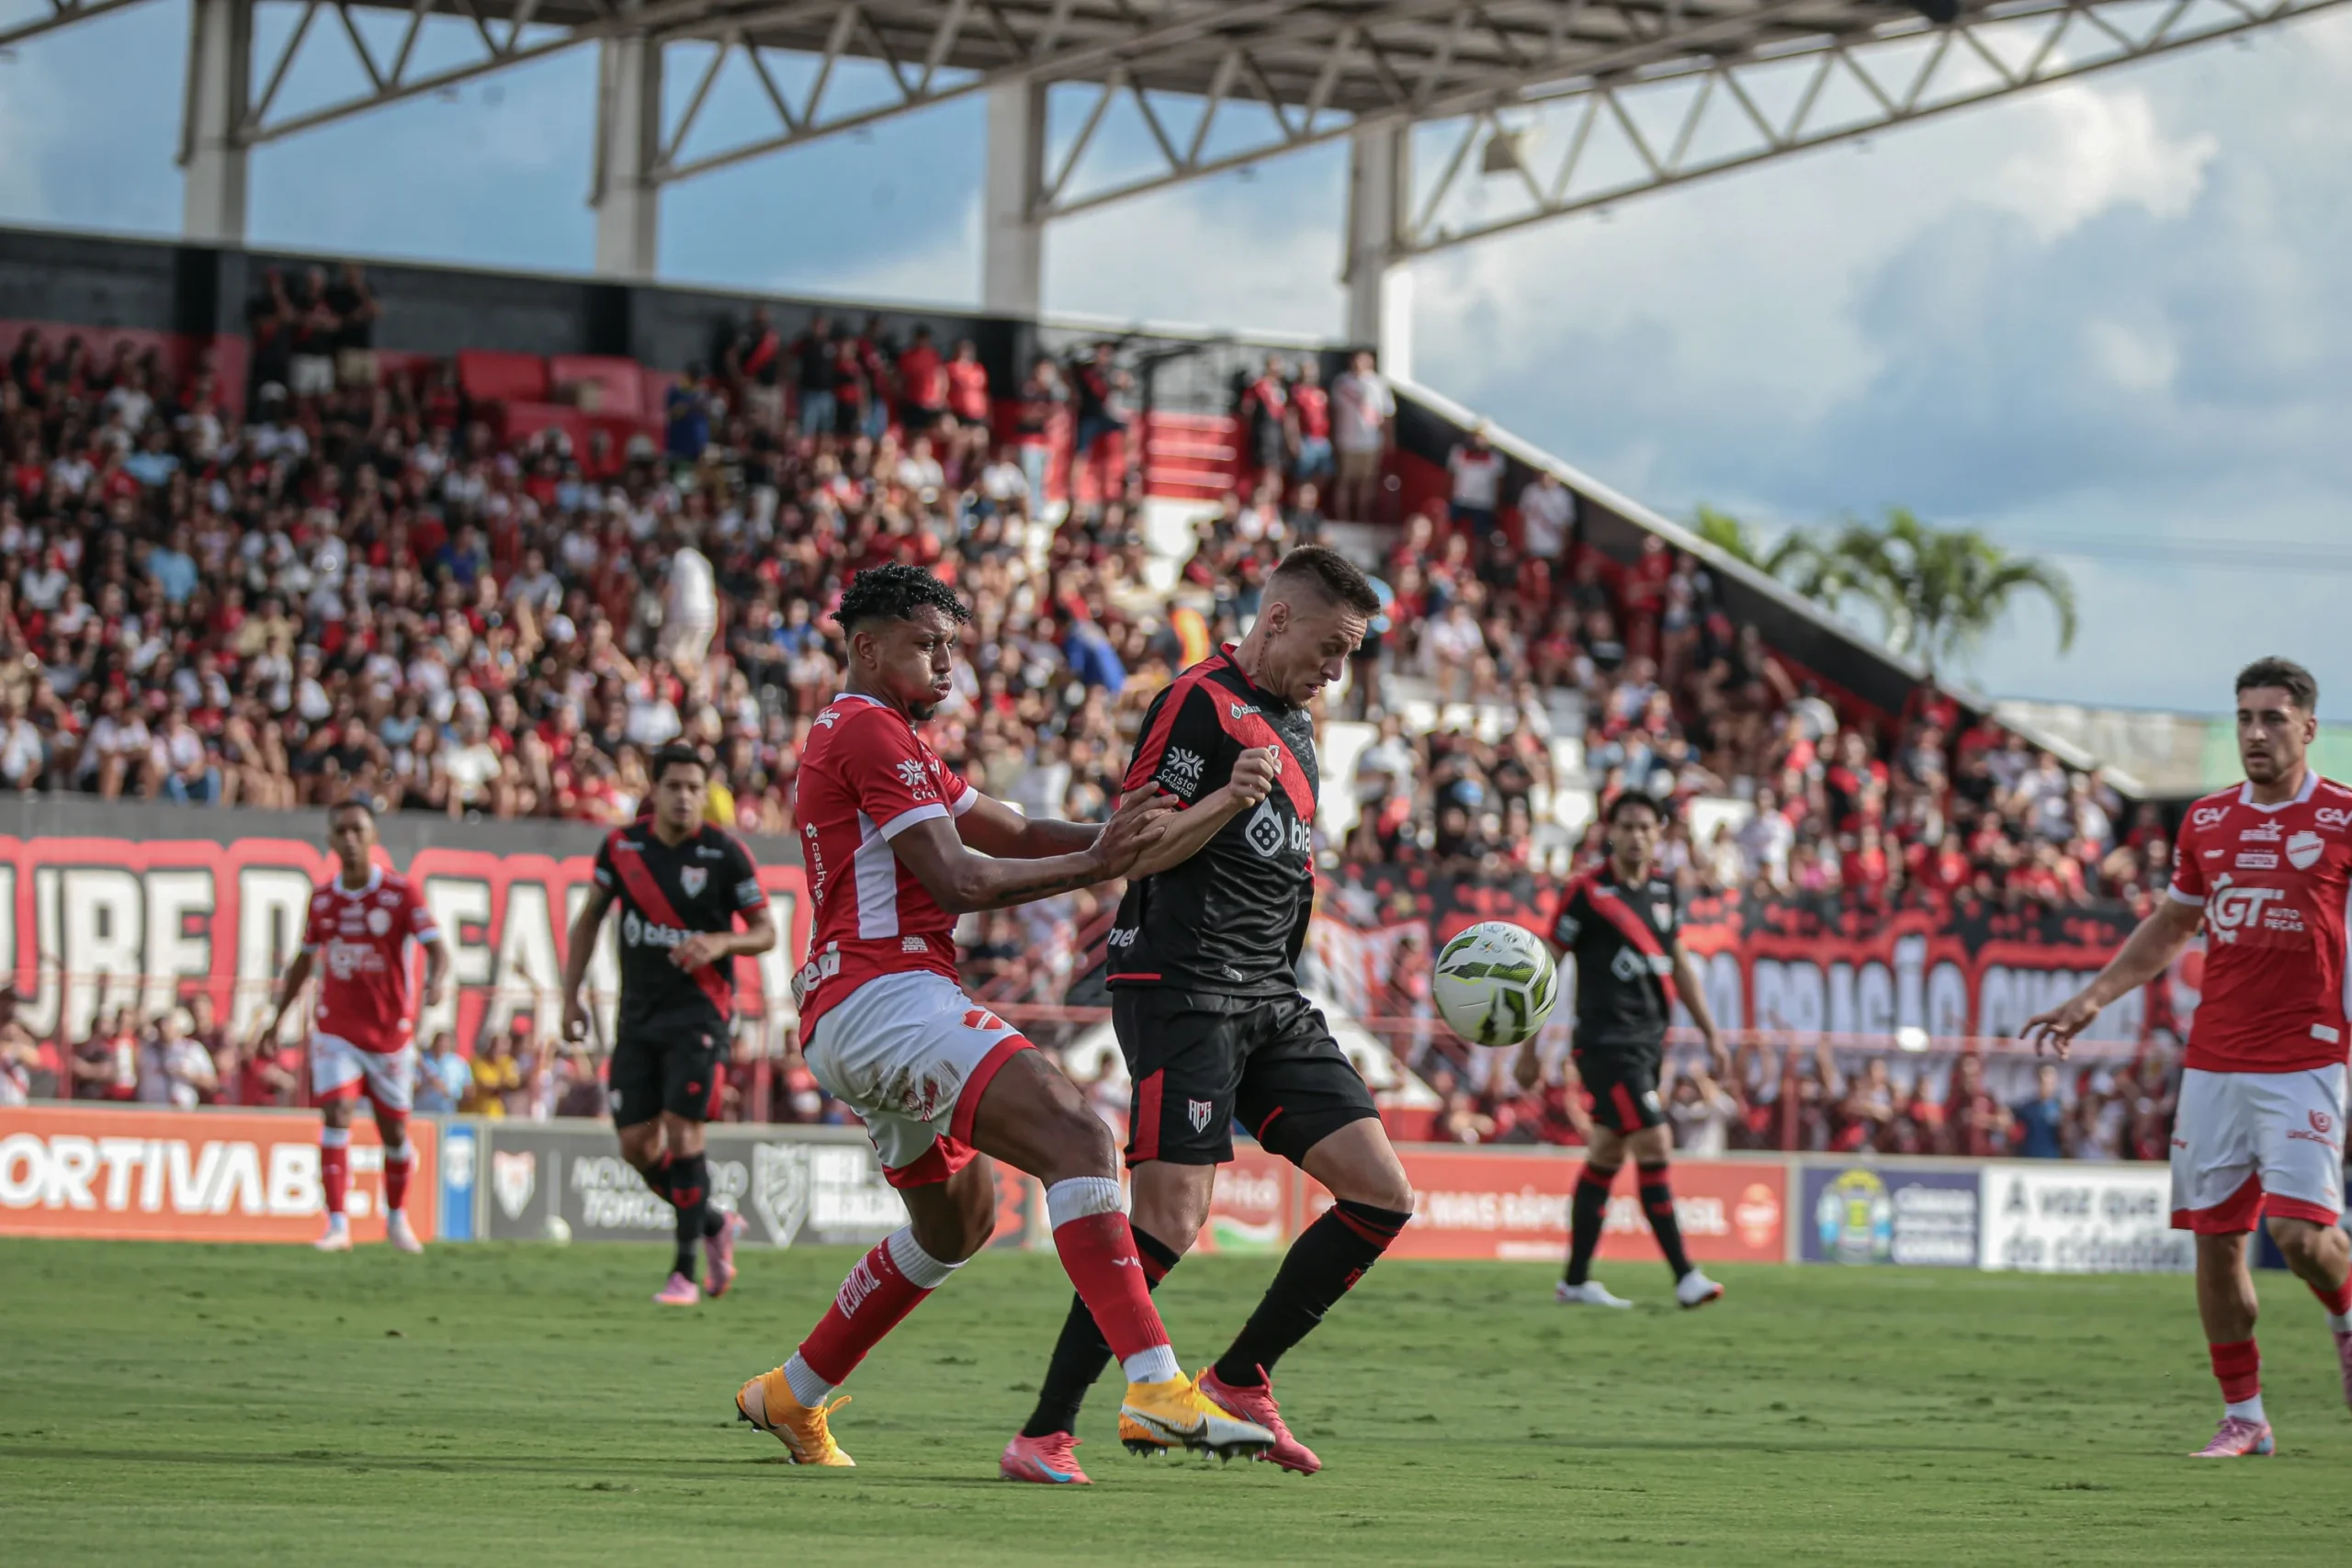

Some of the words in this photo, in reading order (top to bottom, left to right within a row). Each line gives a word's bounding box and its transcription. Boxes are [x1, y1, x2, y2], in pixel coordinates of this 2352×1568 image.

[1241, 704, 1261, 715] blaze
[1161, 768, 1198, 792] Cristal
[1291, 817, 1312, 852] bla
[2215, 887, 2286, 928] GT
[1188, 1099, 1212, 1134] ACG
